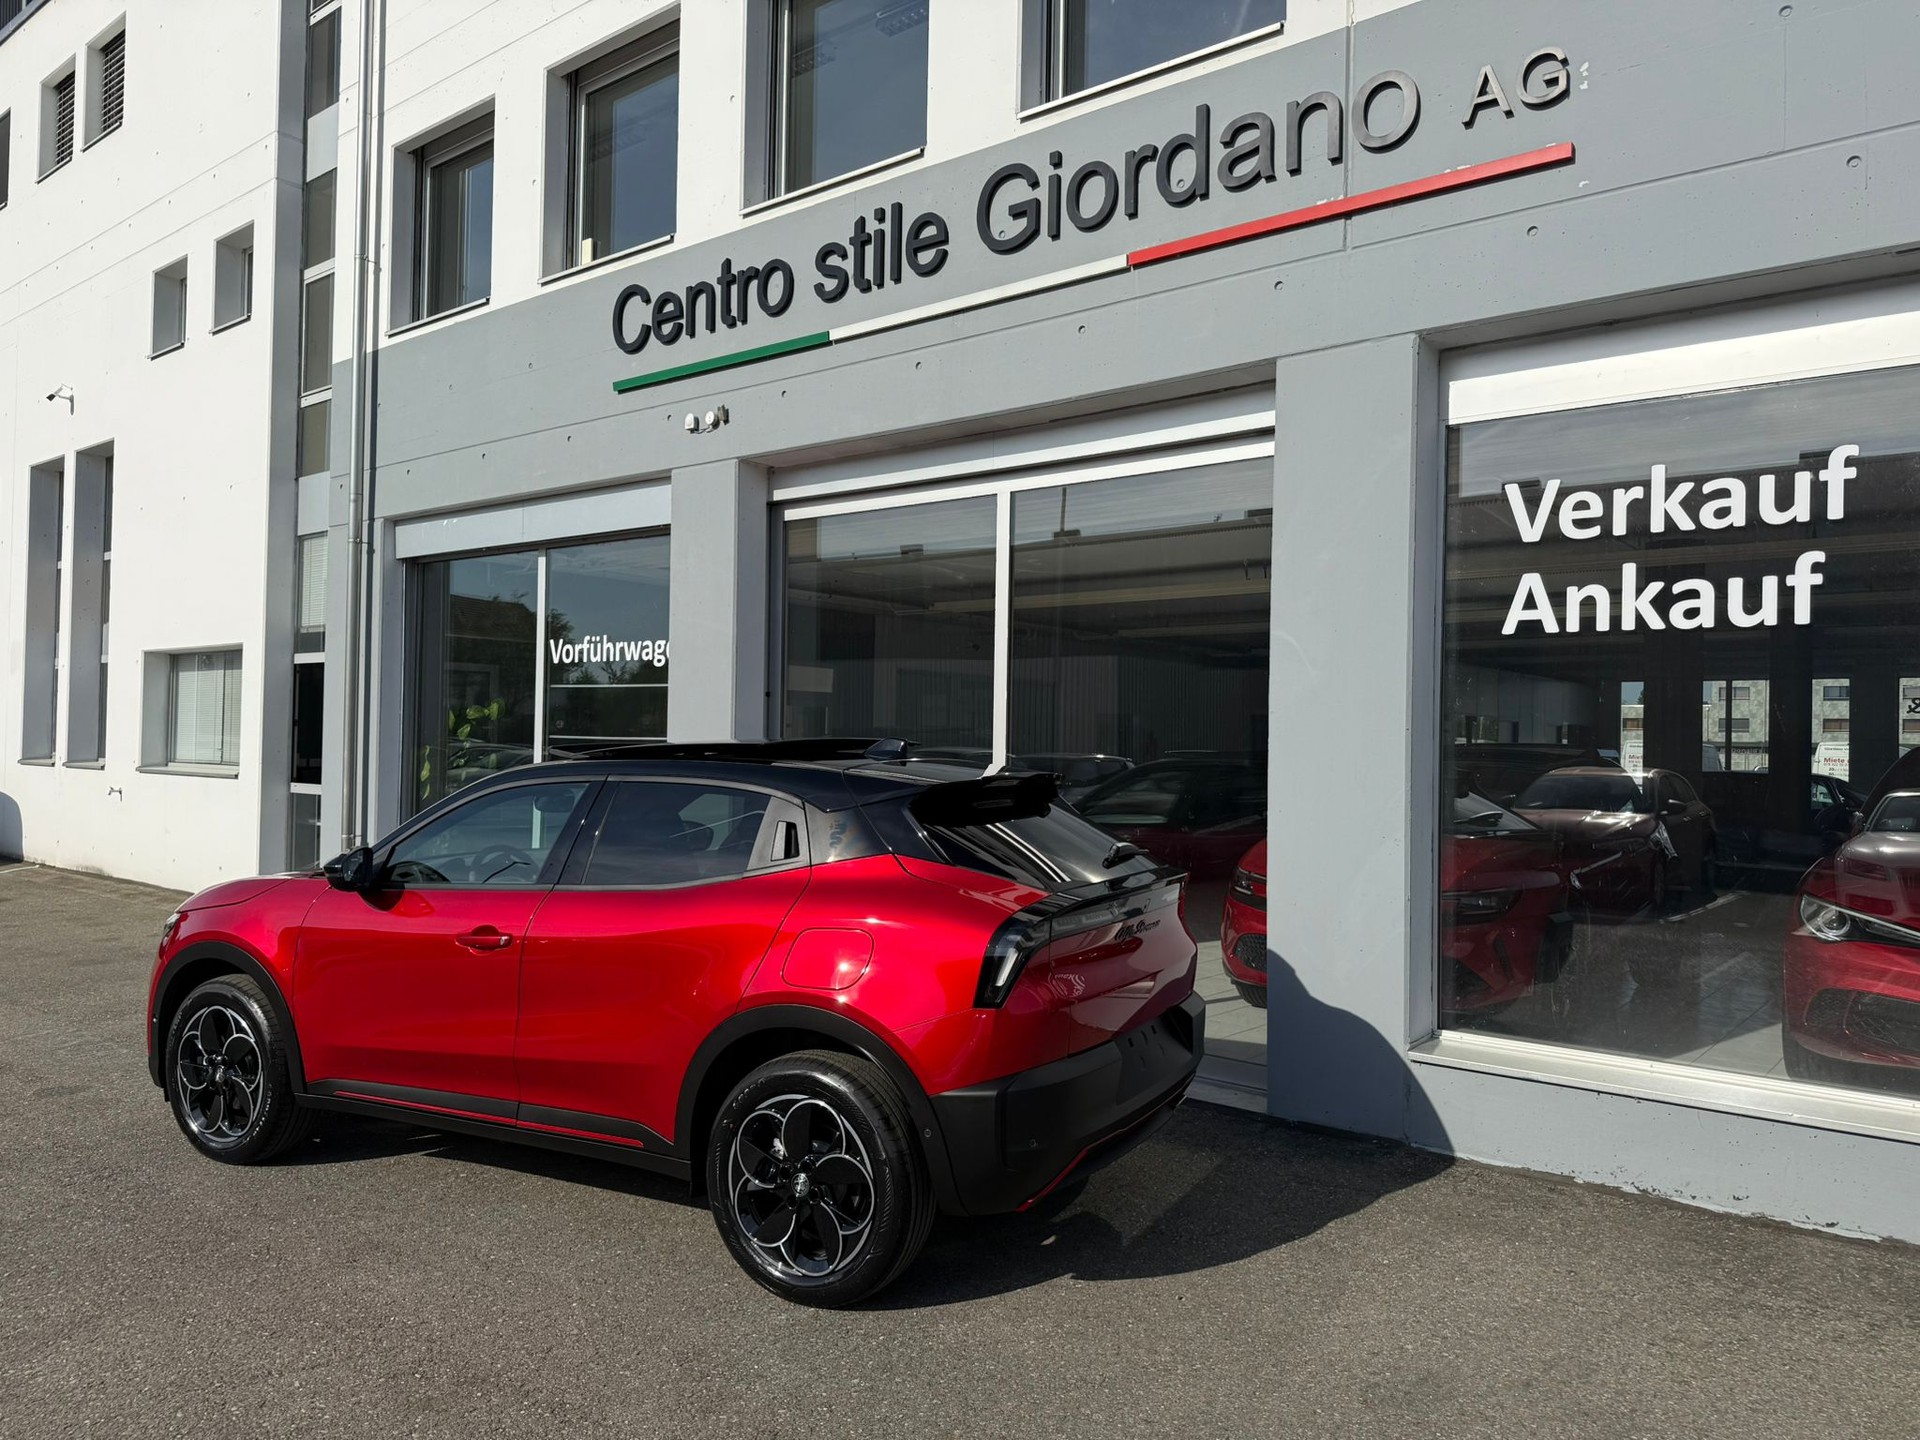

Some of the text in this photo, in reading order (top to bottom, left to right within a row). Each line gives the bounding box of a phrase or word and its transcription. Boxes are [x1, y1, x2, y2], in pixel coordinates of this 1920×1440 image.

[612, 46, 1571, 354] Centro stile Giordano AG
[1504, 444, 1860, 543] Verkauf
[1501, 550, 1826, 635] Ankauf
